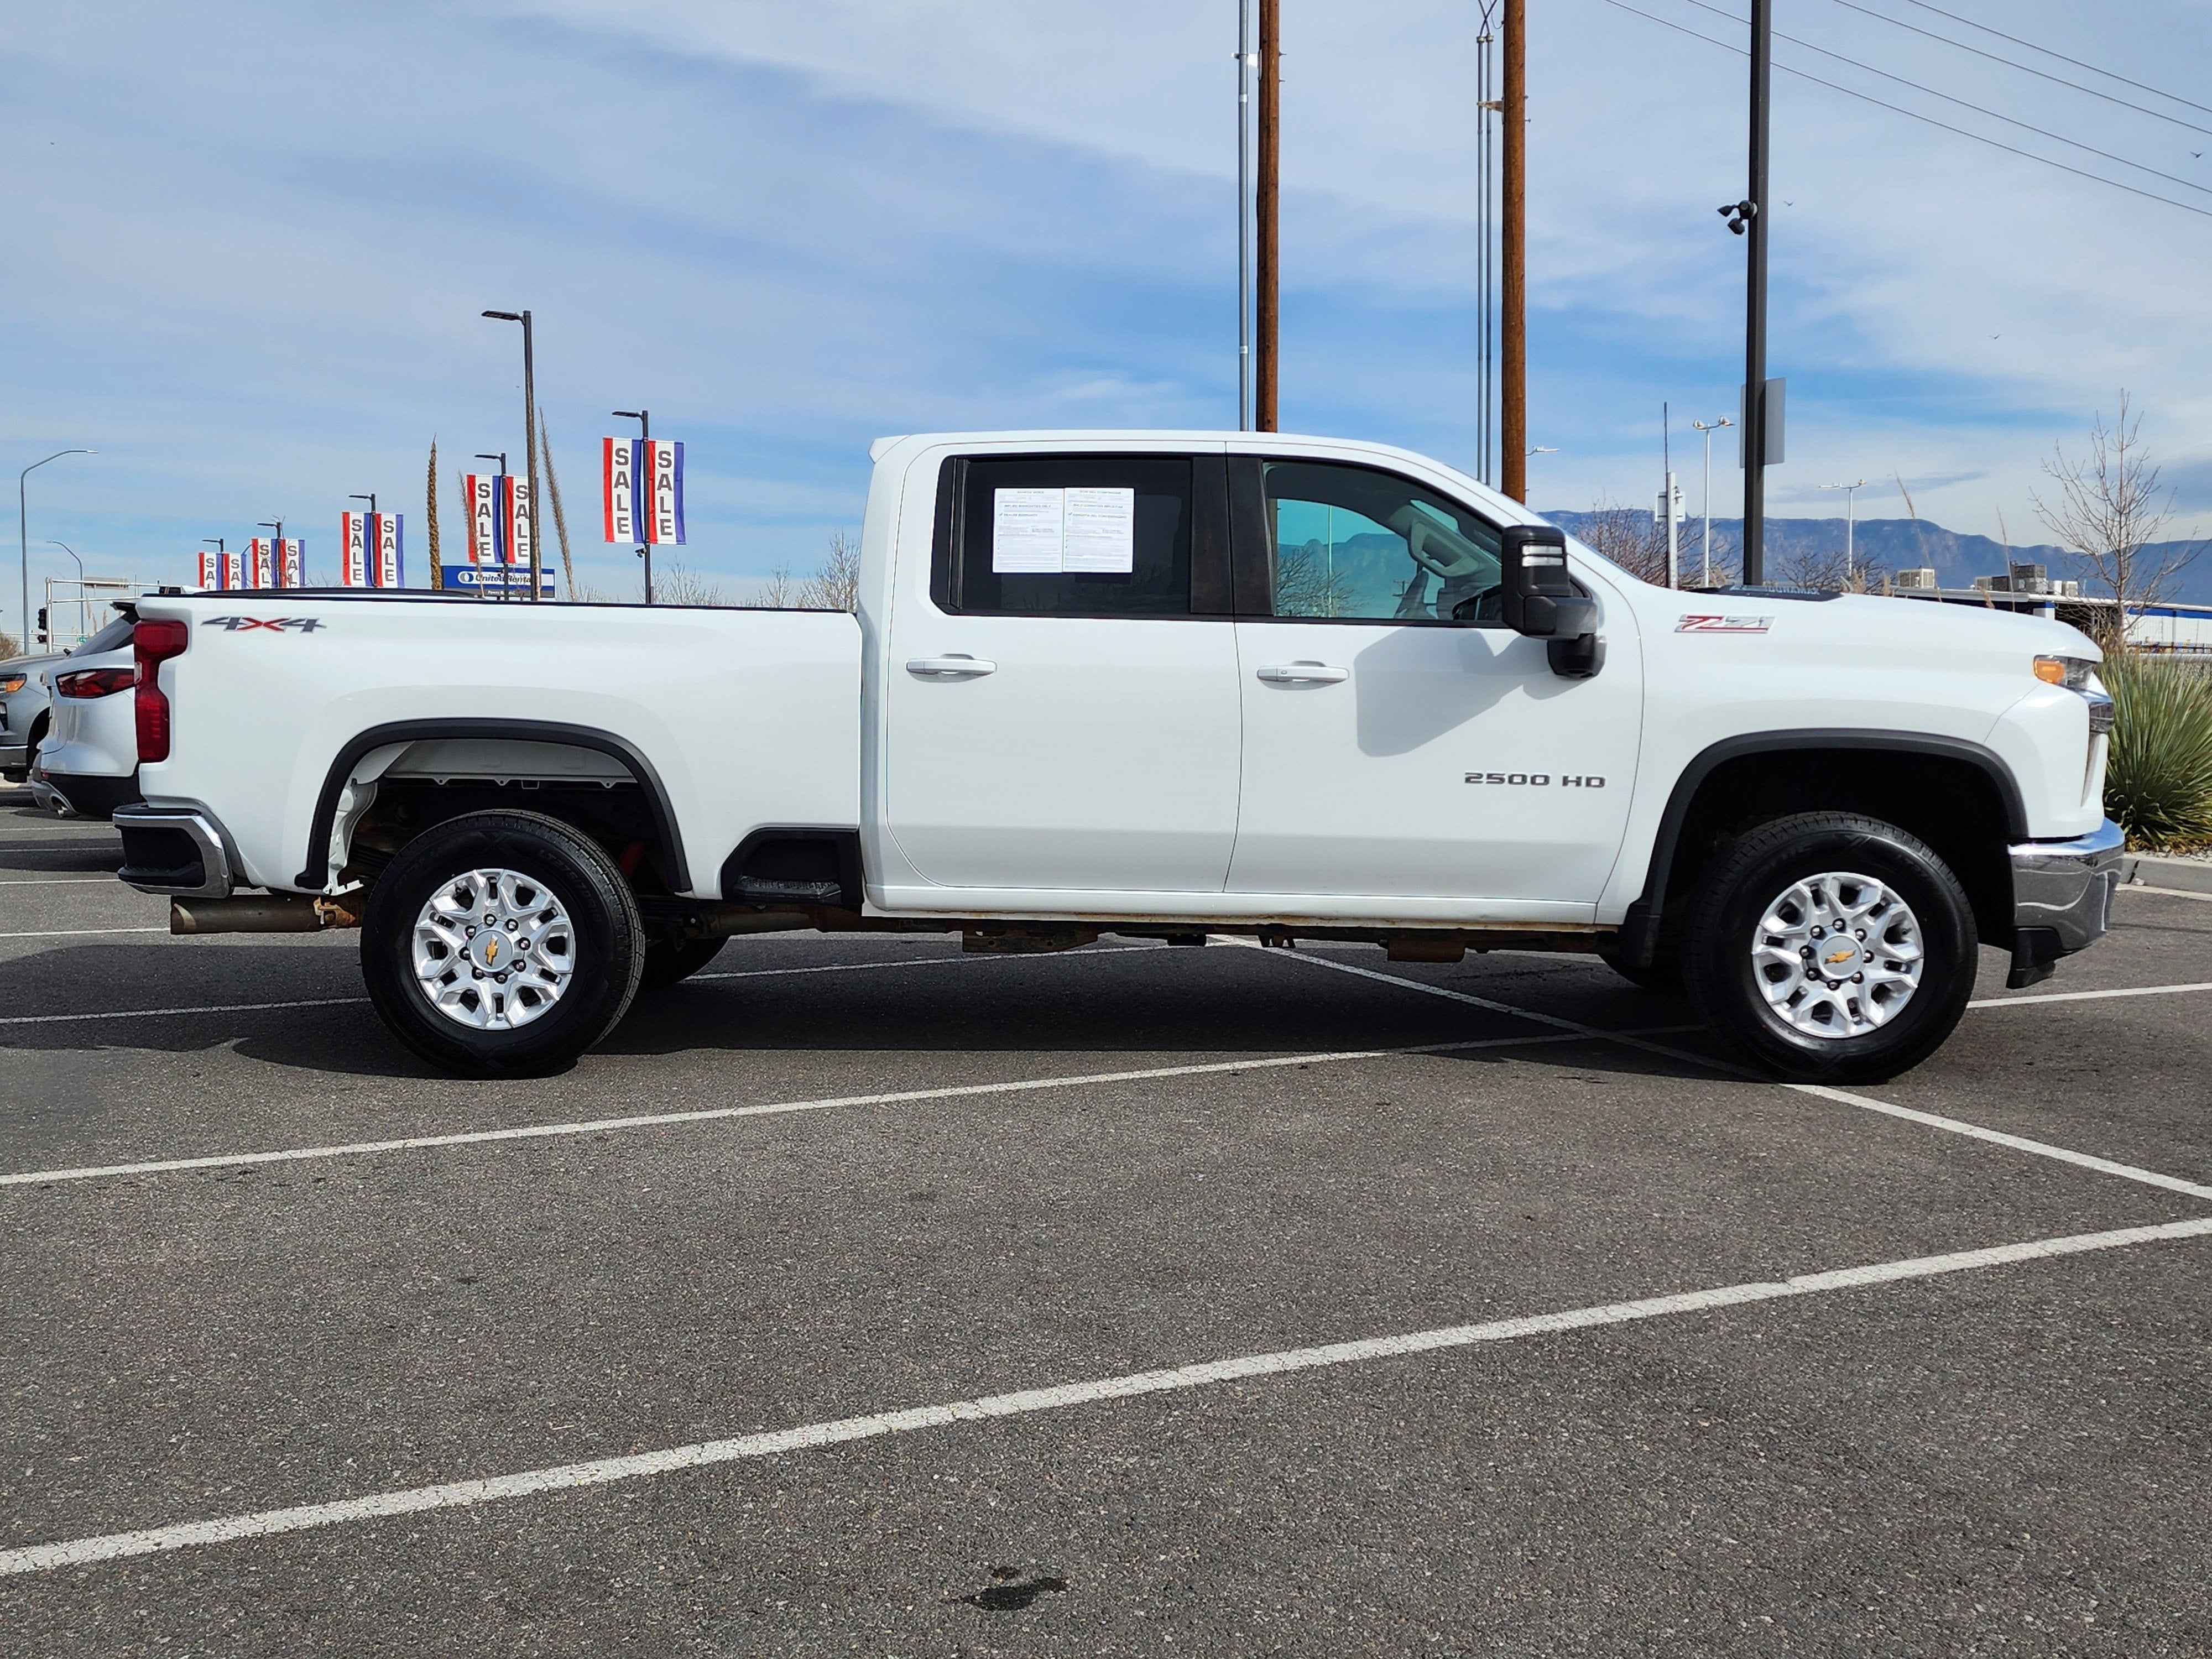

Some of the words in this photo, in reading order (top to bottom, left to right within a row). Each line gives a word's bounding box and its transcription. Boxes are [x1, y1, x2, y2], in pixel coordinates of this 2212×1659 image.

[614, 447, 630, 534] SALE
[657, 450, 672, 536] SALE
[477, 483, 491, 556] SALE
[515, 484, 529, 557] SALE
[259, 544, 270, 589] SAL
[287, 545, 298, 585] SAL
[351, 519, 363, 581] SALE
[383, 520, 395, 581] SALE
[206, 558, 215, 589] SA
[231, 559, 240, 589] SA
[1767, 586, 1820, 595] DURAMAX
[1674, 614, 1775, 633] Z71
[1464, 772, 1551, 786] 2500
[1562, 775, 1606, 788] HD
